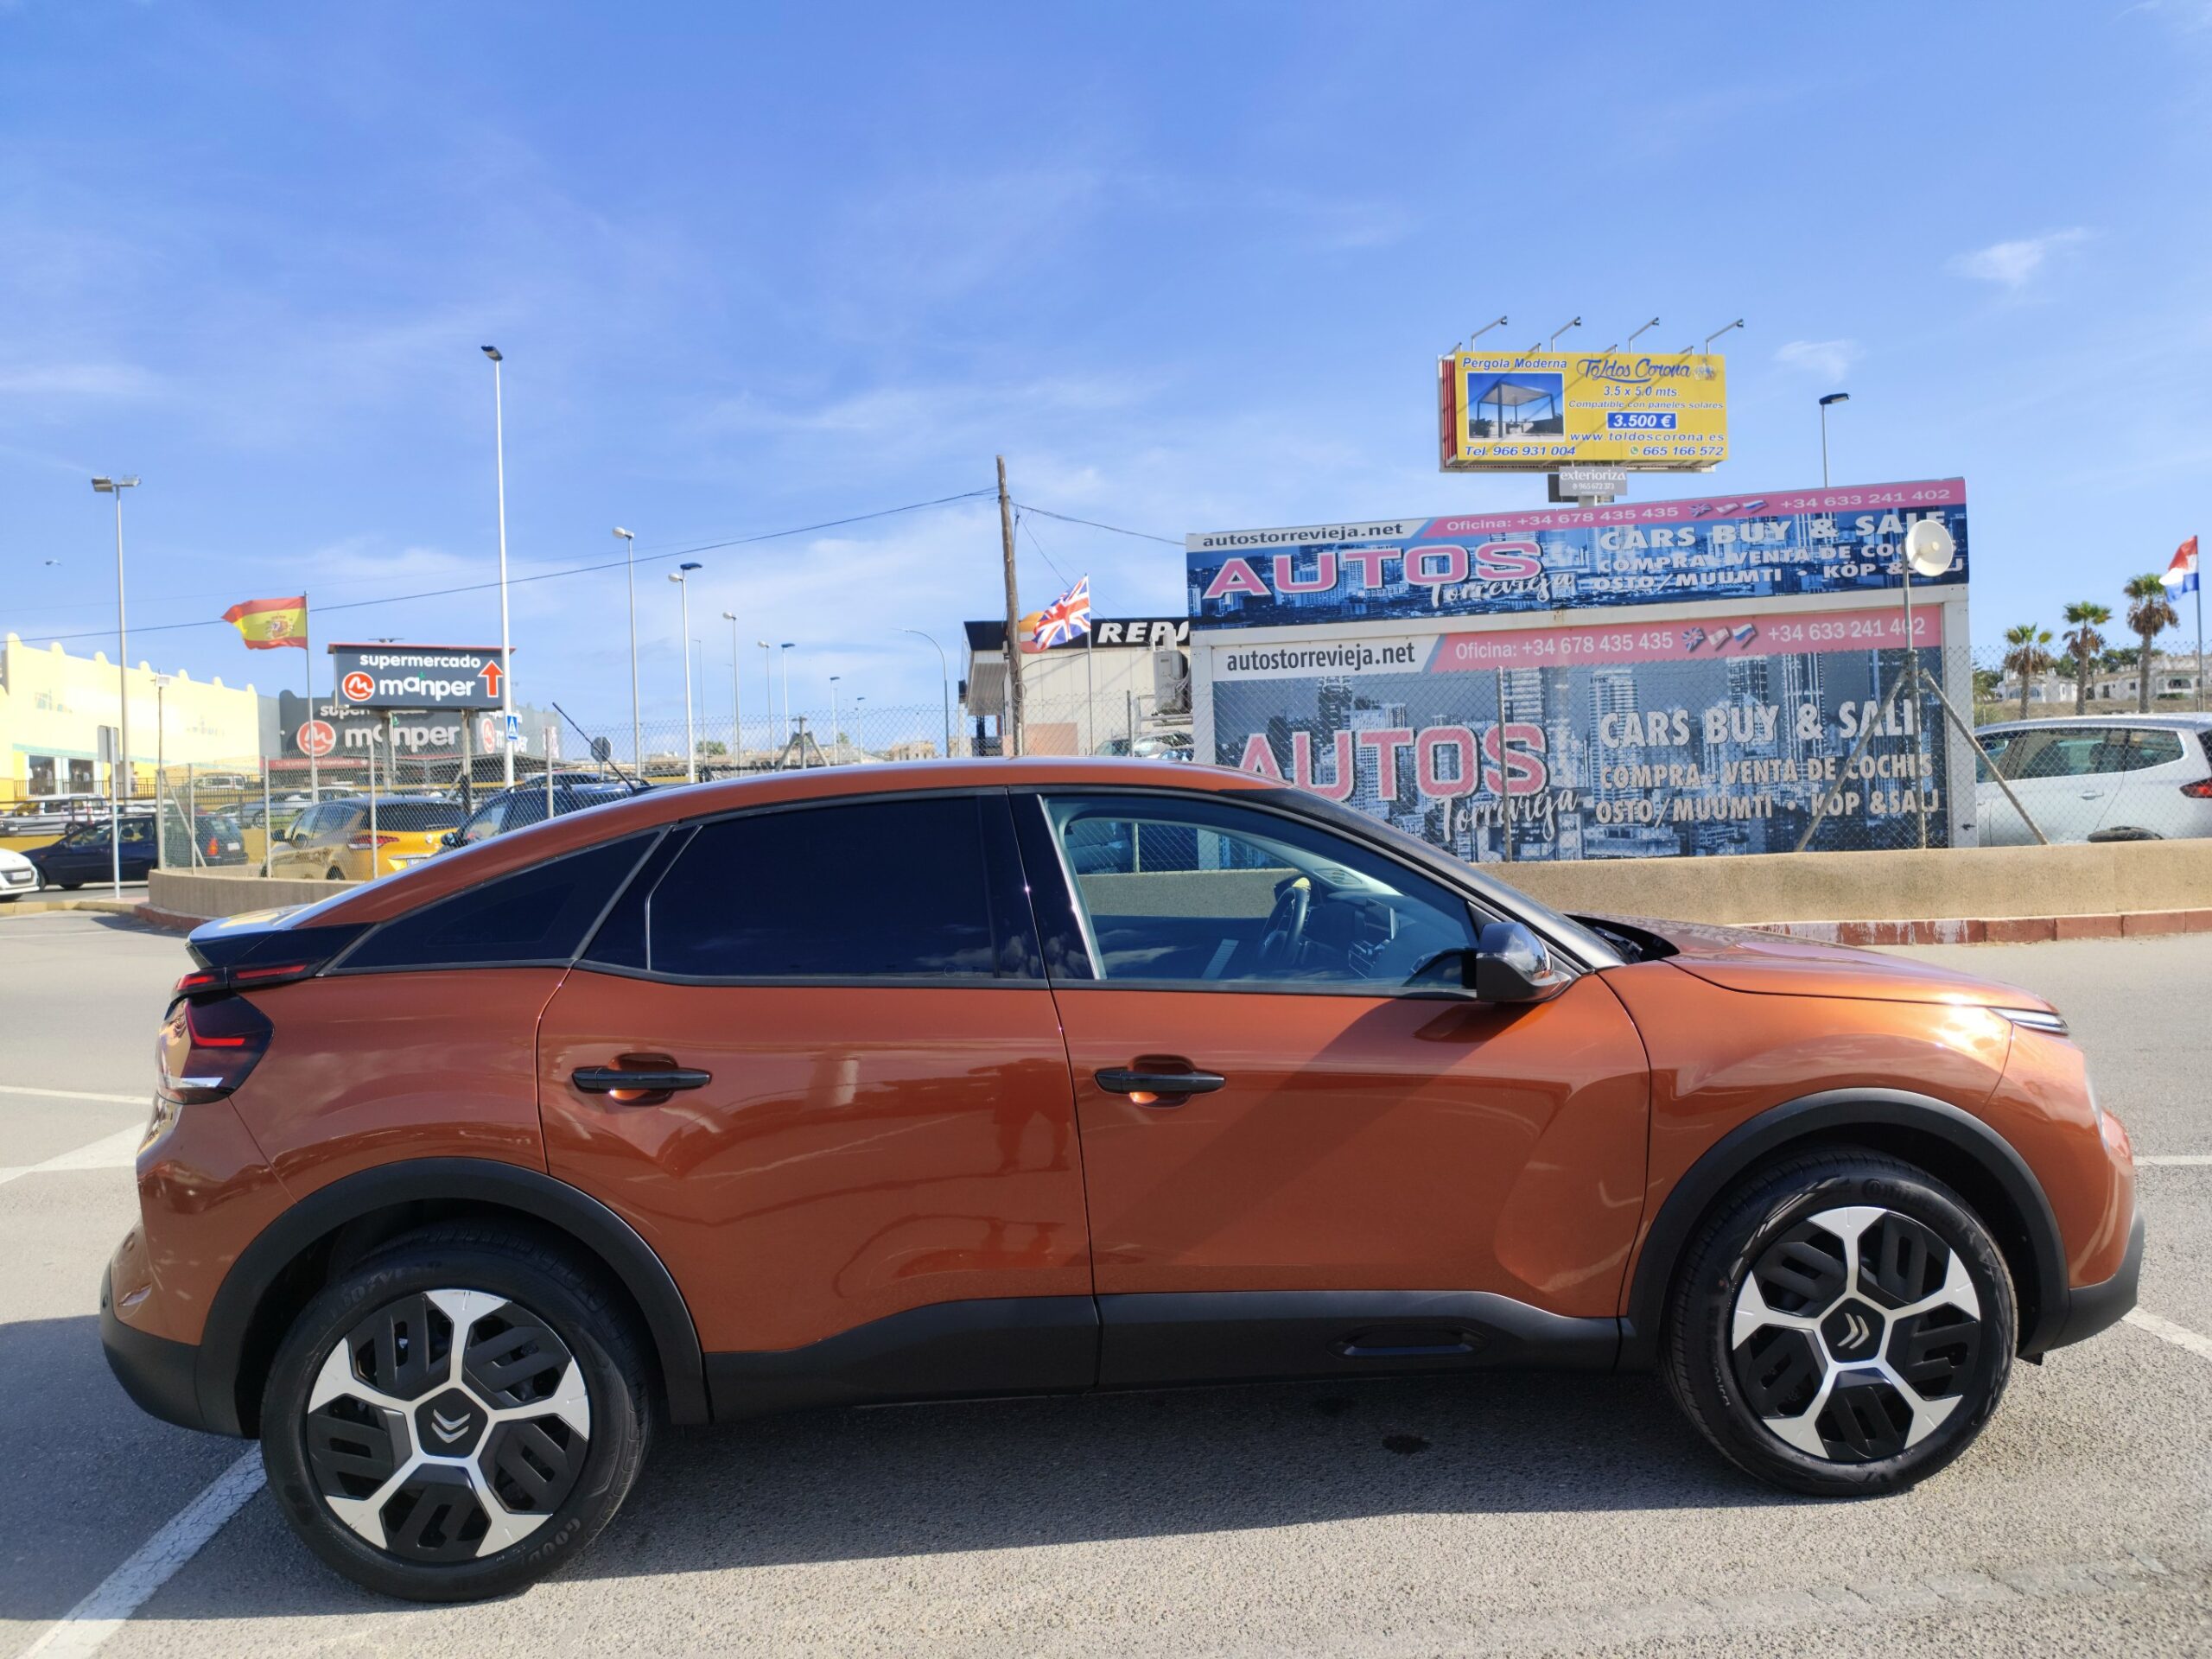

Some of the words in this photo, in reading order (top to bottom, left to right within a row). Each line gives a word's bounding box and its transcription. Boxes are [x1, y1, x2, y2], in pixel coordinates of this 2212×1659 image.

[1514, 359, 1567, 368] Moderna
[1577, 359, 1637, 382] Toldos
[1636, 359, 1691, 378] Corona
[1569, 400, 1624, 410] Compatible
[1648, 400, 1686, 410] paneles
[1613, 415, 1657, 427] 3.500
[1661, 415, 1672, 427] €
[1465, 446, 1488, 456] Tel.
[1493, 446, 1518, 456] 966
[1522, 446, 1546, 456] 931
[1551, 446, 1575, 456] 004
[1643, 446, 1668, 456] 665
[1673, 446, 1695, 456] 166
[1700, 446, 1725, 456] 572
[1560, 469, 1626, 480] exterioriza
[1781, 498, 1818, 509] +34
[1824, 495, 1862, 506] 633
[1868, 492, 1906, 504] 241
[1911, 489, 1950, 501] 402
[1446, 518, 1512, 532] Oficina:
[1516, 514, 1554, 526] +34
[1558, 512, 1594, 524] 678
[1599, 509, 1637, 521] 435
[1642, 506, 1679, 518] 435
[1202, 523, 1403, 547] autostorrevieja.net
[1600, 526, 1696, 551] CARS
[1713, 520, 1792, 545] BUY
[1810, 518, 1839, 539] &
[1202, 541, 1544, 600] AUTOS
[1599, 554, 1707, 574] COMPRA
[1730, 547, 1810, 565] VENTA
[1820, 545, 1851, 560] DE
[1823, 561, 1876, 579] KÖP
[1424, 571, 1574, 607] Torrevieja
[1768, 623, 1803, 643] +34
[1808, 621, 1845, 640] 633
[1850, 619, 1885, 638] 241
[1227, 642, 1415, 671] autostorrevieja.net
[1455, 642, 1516, 659] Oficina:
[1522, 639, 1555, 656] +34
[1560, 636, 1595, 654] 678
[1599, 633, 1633, 652] 435
[1638, 632, 1674, 649] 435
[359, 654, 481, 670] supermercado
[379, 676, 476, 702] manper
[1600, 709, 1691, 749] CARS
[1705, 705, 1779, 744] BUY
[1796, 702, 1824, 741] &
[1239, 722, 1548, 803] AUTOS
[1600, 763, 1702, 789] COMPRA
[1724, 759, 1798, 785] VENTA
[1808, 758, 1836, 781] DE
